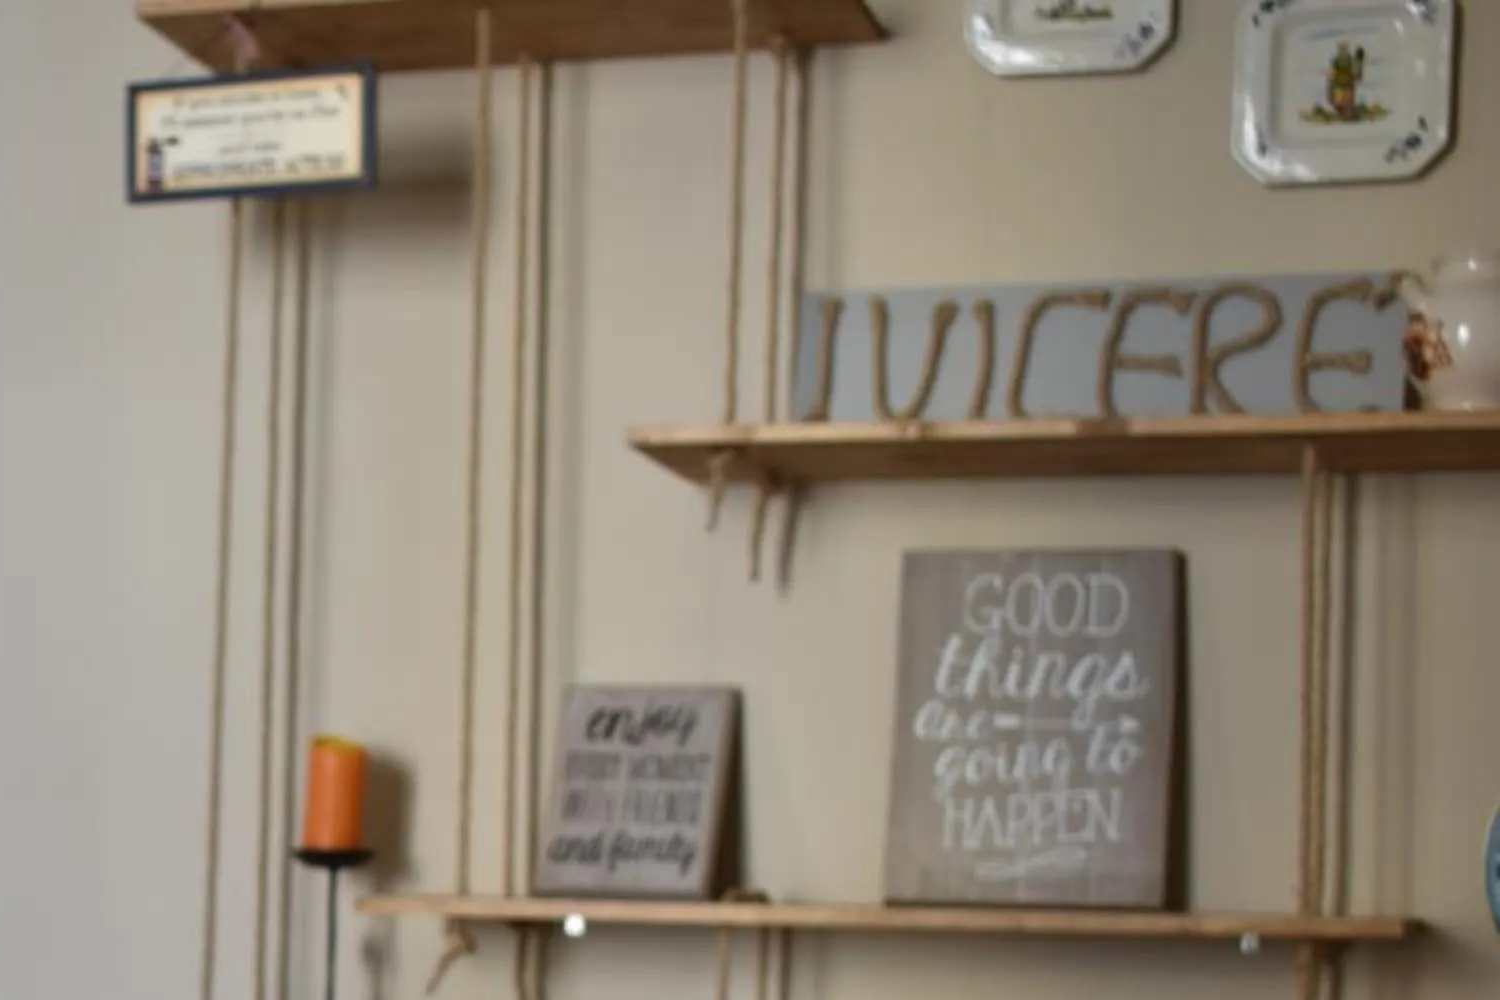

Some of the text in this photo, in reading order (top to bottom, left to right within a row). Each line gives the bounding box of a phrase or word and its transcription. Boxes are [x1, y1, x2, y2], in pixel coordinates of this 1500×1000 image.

[962, 570, 1130, 640] GOOD
[933, 632, 1150, 731] things
[584, 697, 699, 748] enjoy
[931, 712, 1142, 803] going to
[545, 831, 604, 864] and
[941, 787, 1122, 850] HAPPEN
